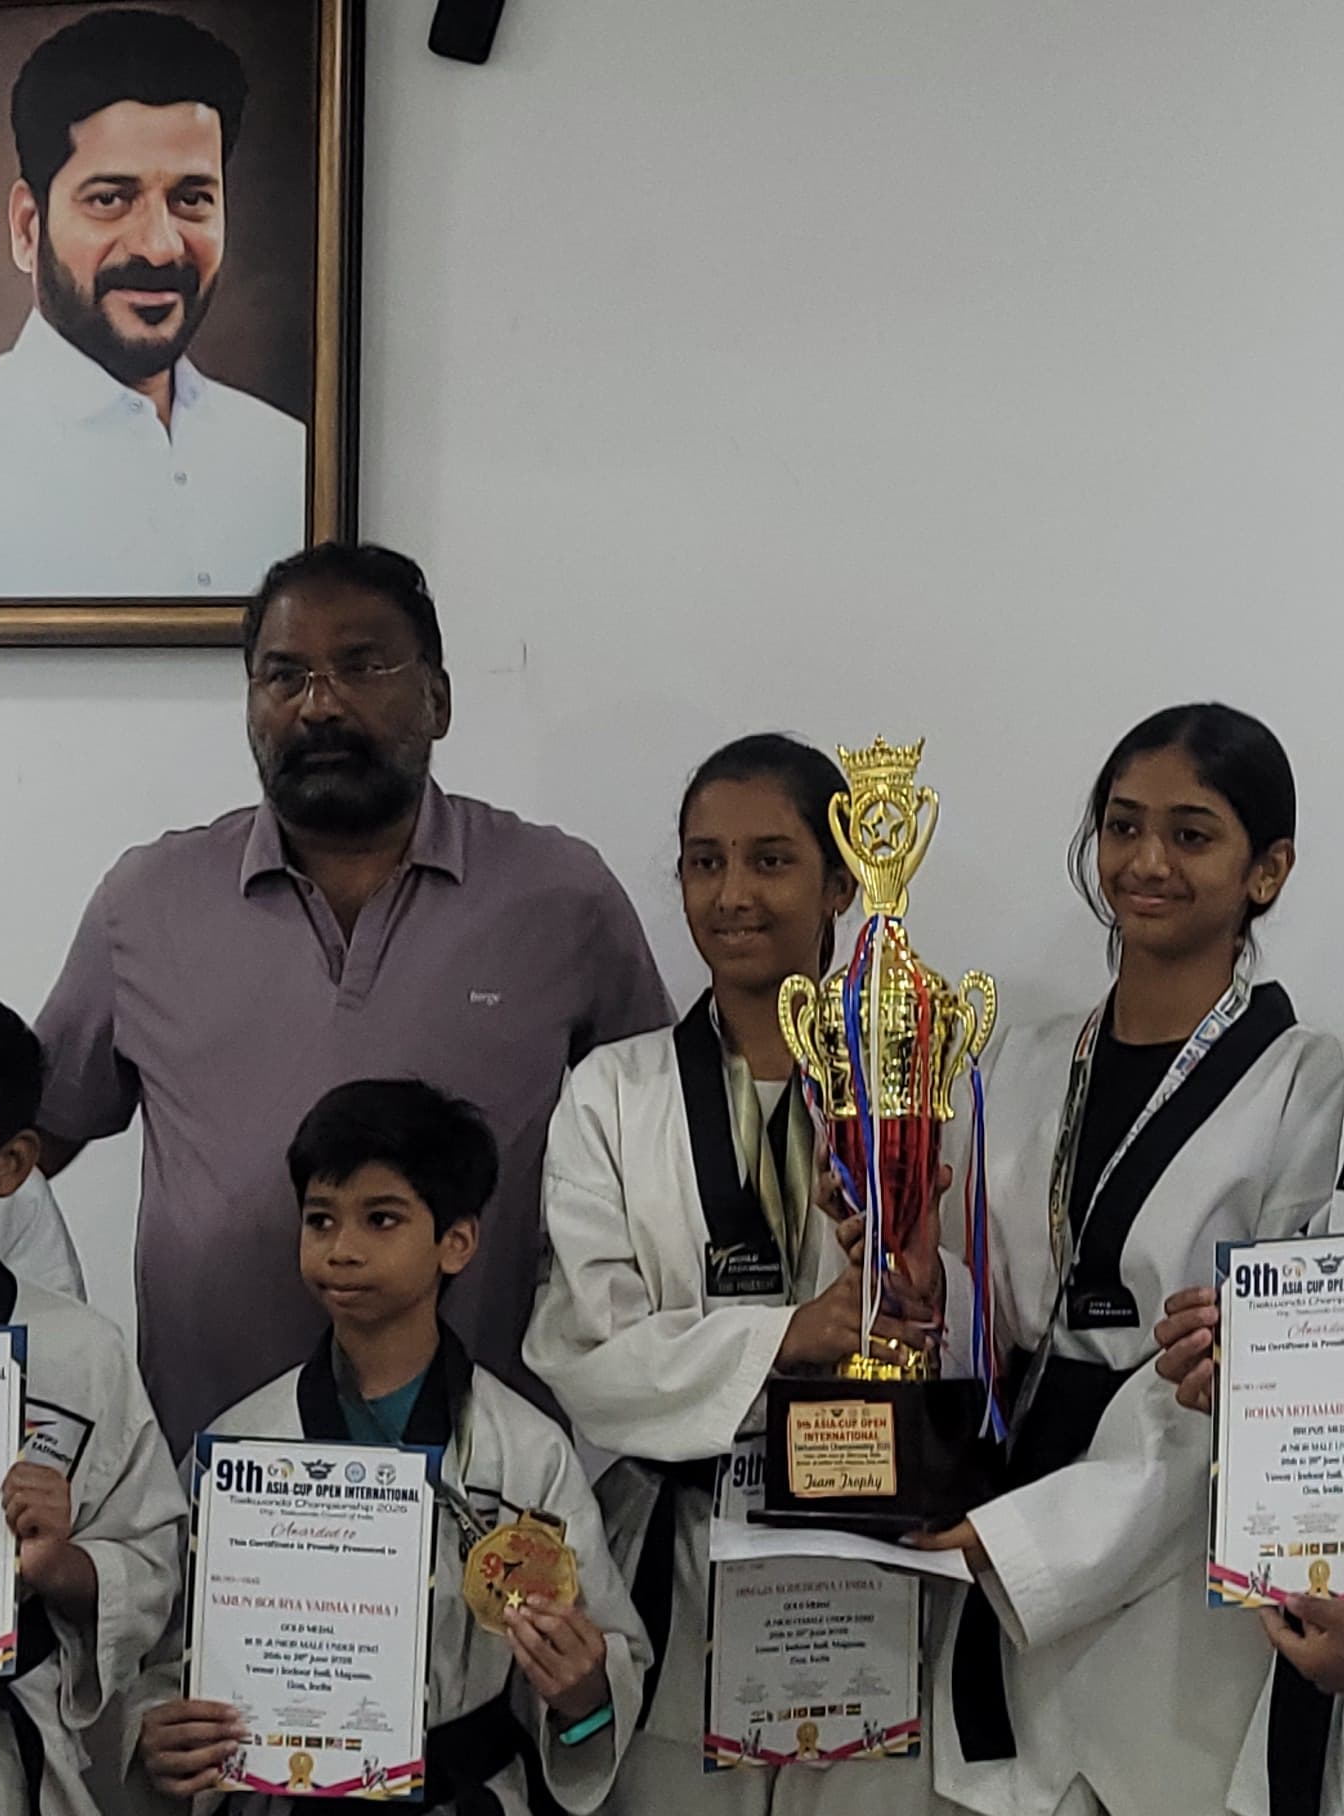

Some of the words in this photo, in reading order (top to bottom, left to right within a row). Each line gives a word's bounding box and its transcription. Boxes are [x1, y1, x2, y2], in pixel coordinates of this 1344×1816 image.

[1236, 1263, 1278, 1298] 9th
[1282, 1282, 1303, 1296] ASIA
[1307, 1280, 1324, 1293] CUP
[860, 1417, 887, 1428] OPEN
[804, 1431, 878, 1441] INTERNATIONAL
[216, 1458, 263, 1493] 9th
[266, 1481, 288, 1496] ASIA
[293, 1483, 312, 1496] CUP
[316, 1484, 341, 1498] OPEN
[345, 1486, 419, 1503] INTERNATIONAL
[229, 1538, 247, 1547] This
